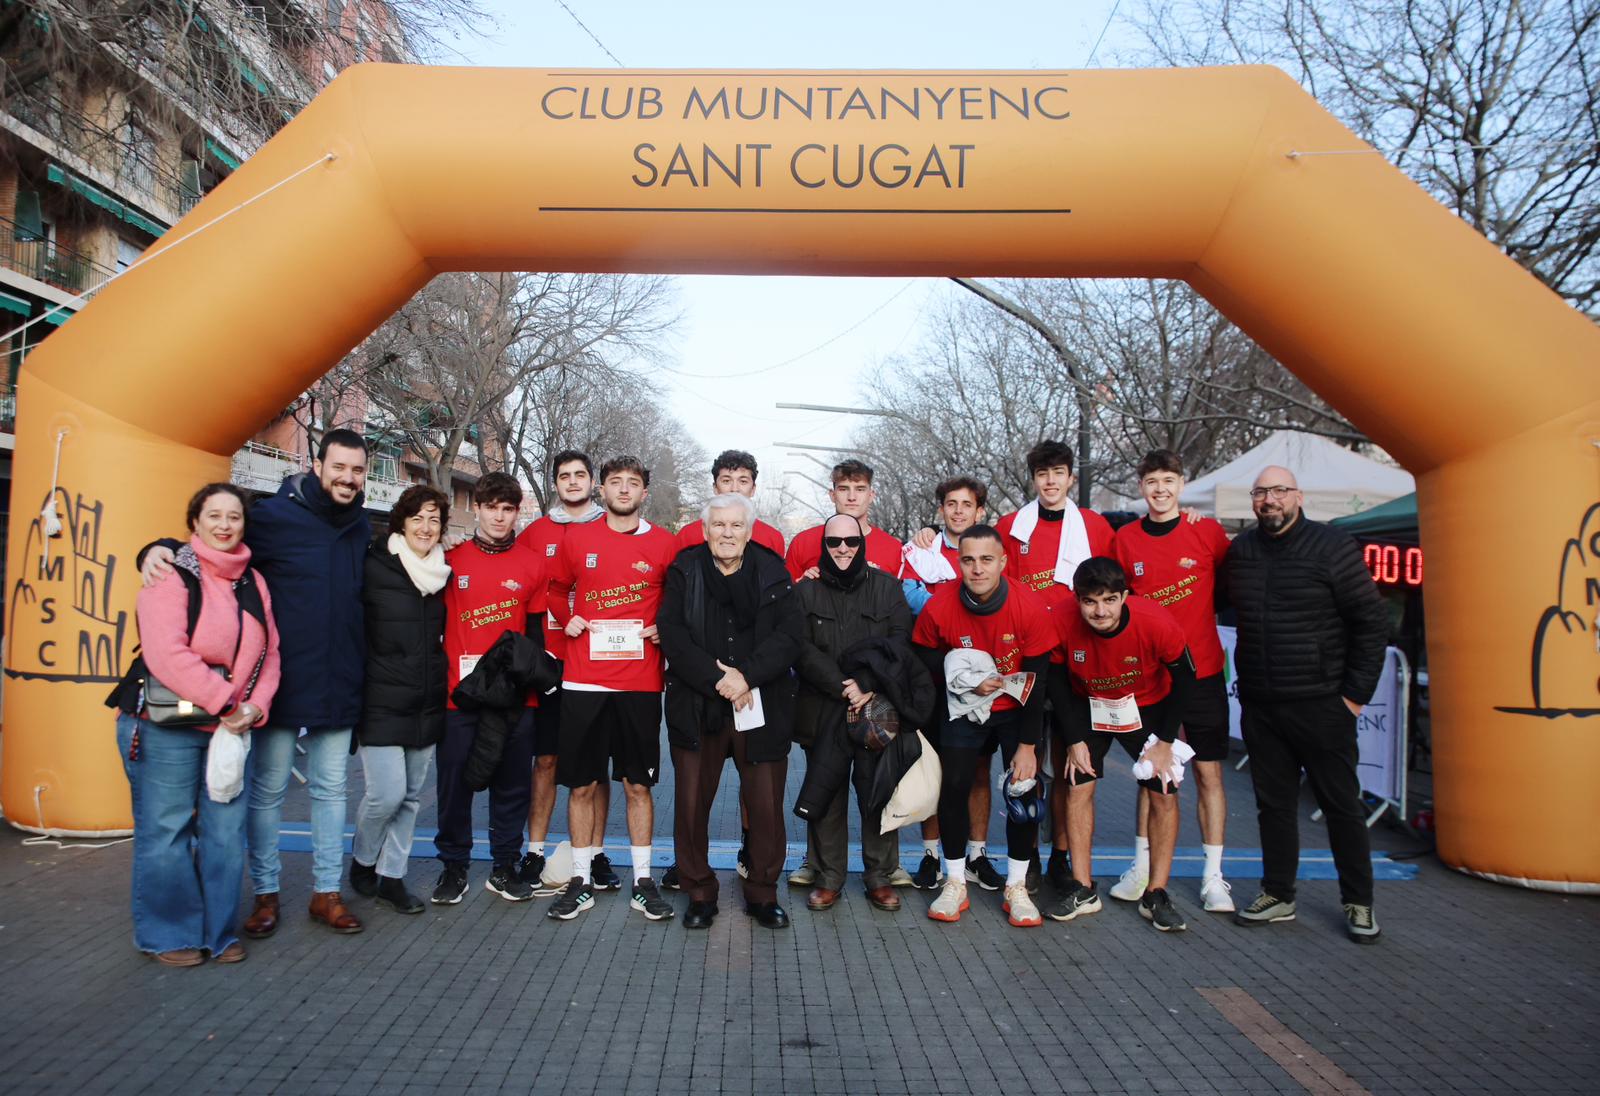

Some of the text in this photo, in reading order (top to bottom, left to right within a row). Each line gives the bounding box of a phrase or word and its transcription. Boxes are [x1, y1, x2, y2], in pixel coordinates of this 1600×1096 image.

[540, 85, 1071, 121] CLUB MUNTANYENC
[631, 142, 975, 189] SANT CUGAT
[585, 581, 650, 602] 20 anys amb
[1152, 584, 1176, 599] anys
[1178, 574, 1198, 588] amb
[460, 598, 519, 622] 20 anys amb
[597, 593, 642, 610] l'escola
[470, 611, 512, 629] l'escola
[607, 634, 626, 645] ALEX
